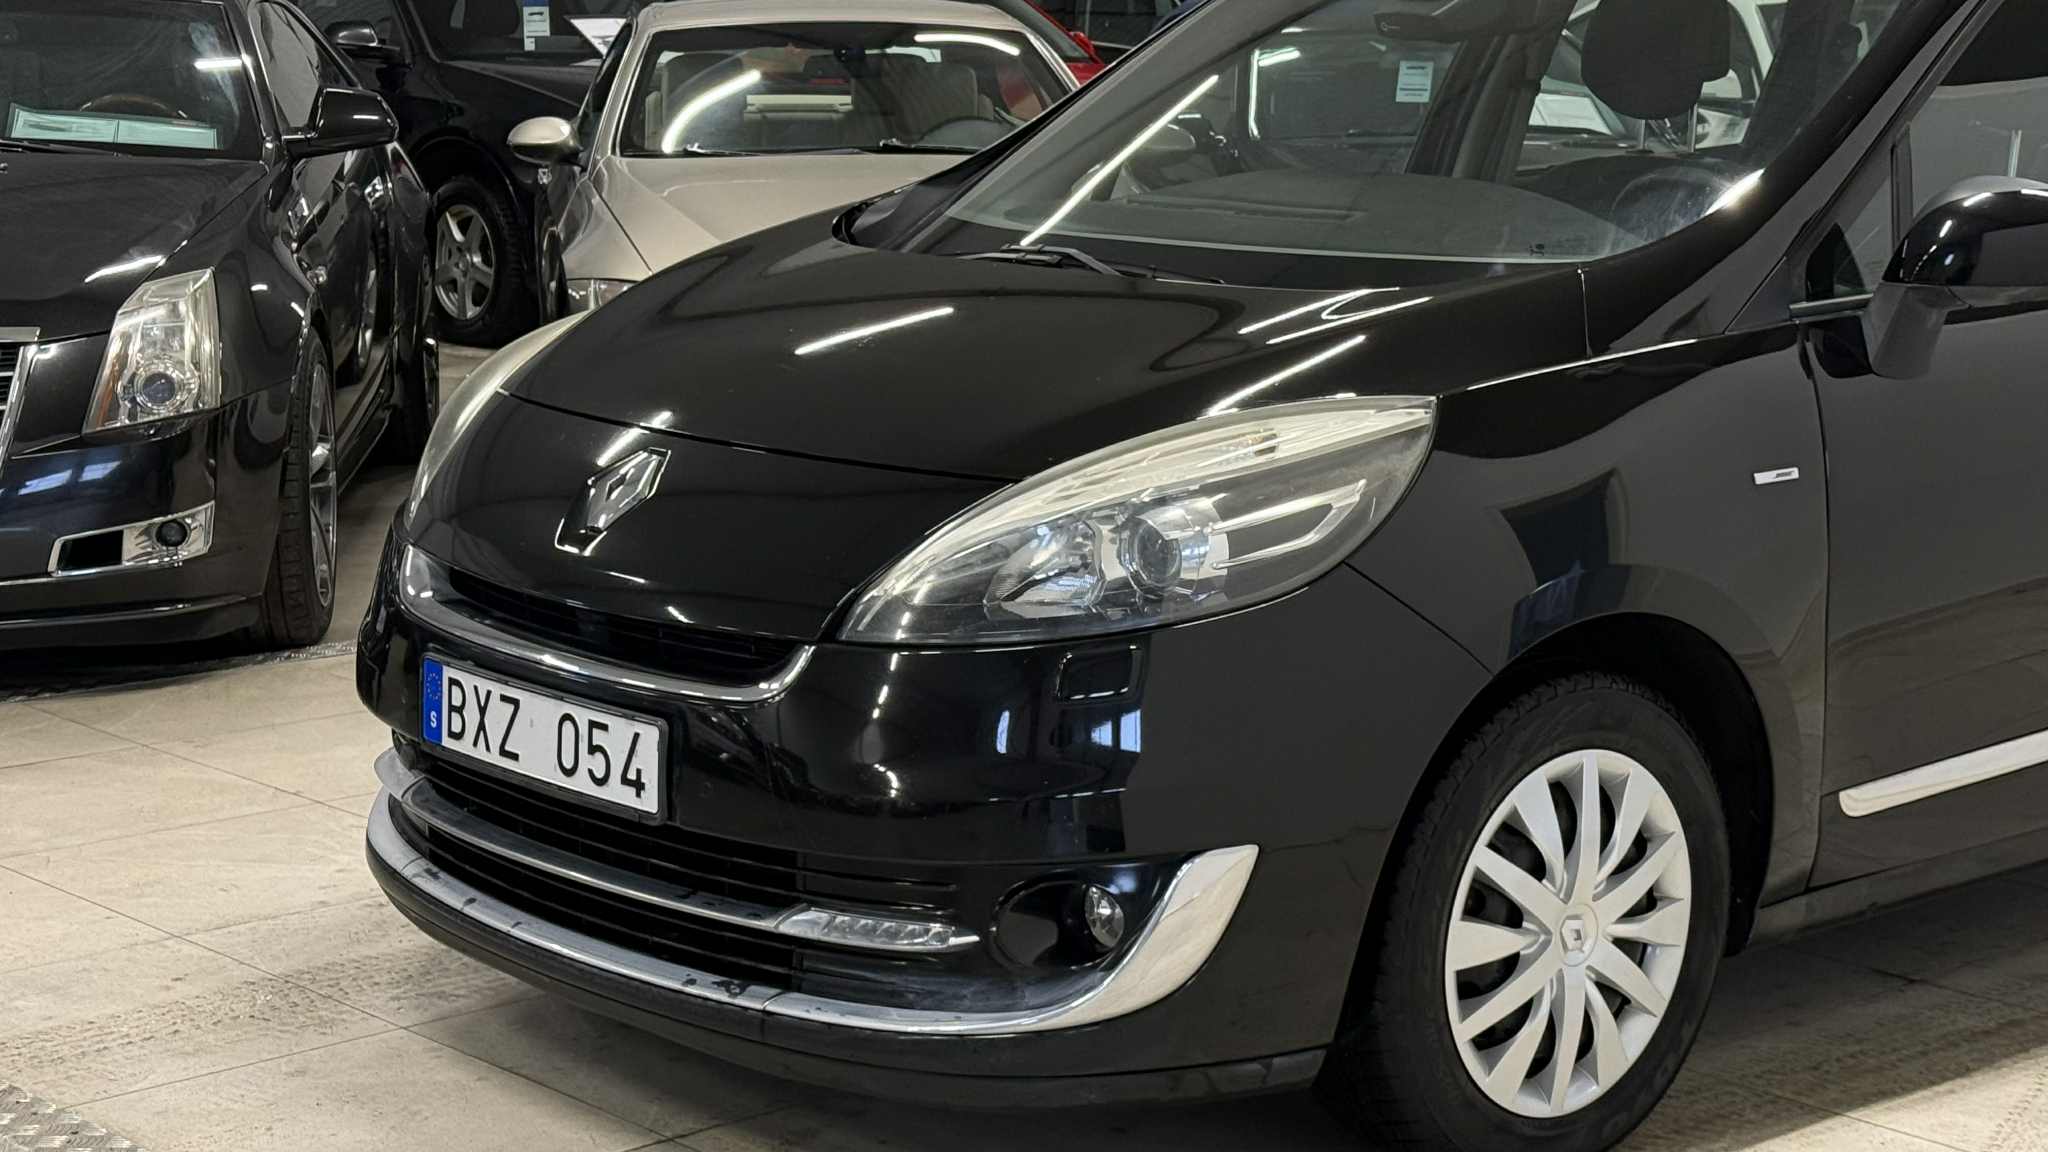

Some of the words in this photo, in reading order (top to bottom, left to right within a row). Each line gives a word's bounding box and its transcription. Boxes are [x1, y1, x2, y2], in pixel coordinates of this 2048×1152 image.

[430, 711, 438, 729] S
[447, 677, 520, 761] BXZ
[558, 713, 645, 799] 054
